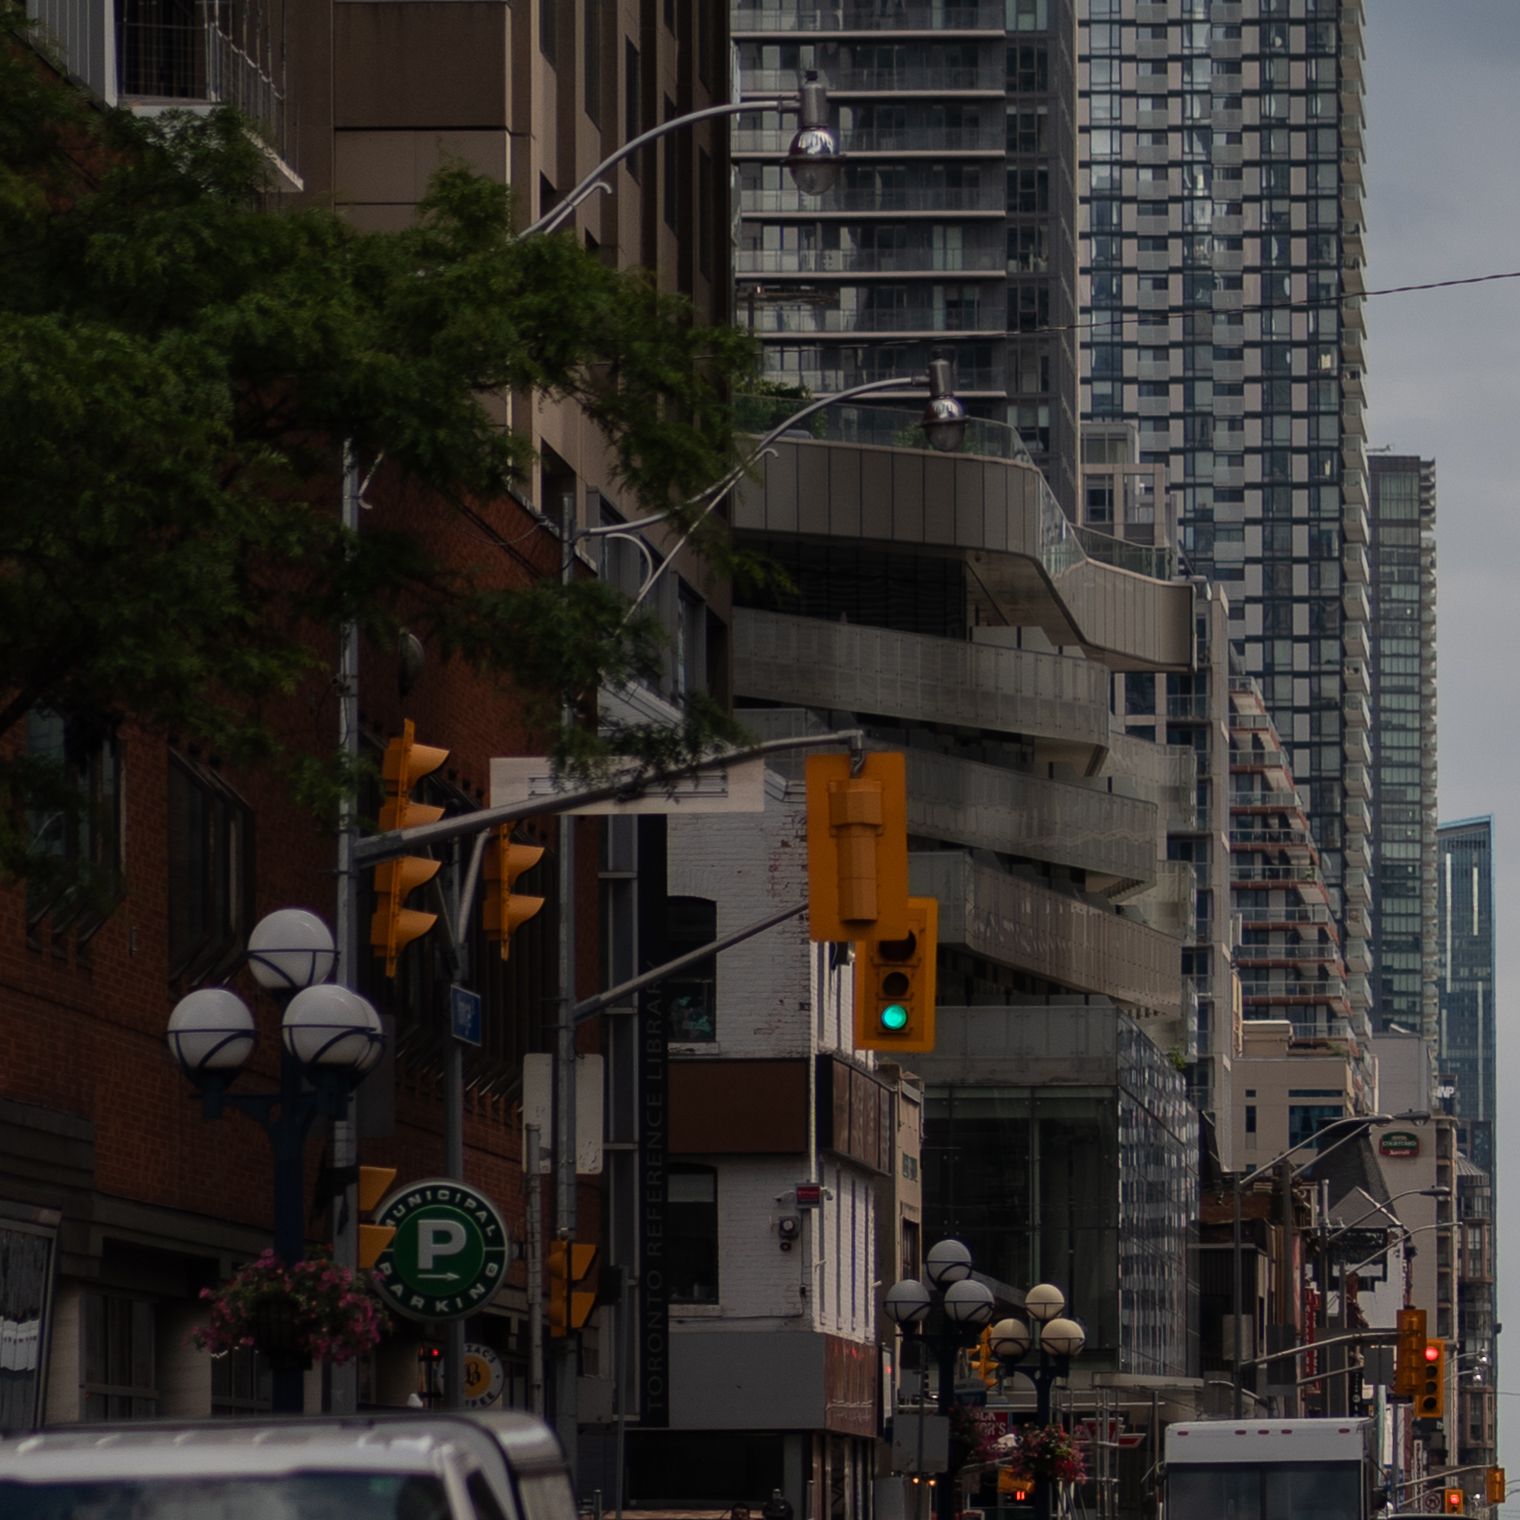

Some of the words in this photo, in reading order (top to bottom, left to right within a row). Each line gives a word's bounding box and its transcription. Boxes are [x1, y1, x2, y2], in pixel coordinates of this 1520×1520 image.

[647, 1092, 663, 1256] REFERENCE
[378, 1261, 500, 1313] PARKING
[417, 1218, 467, 1270] P
[647, 1269, 664, 1411] TORONTO
